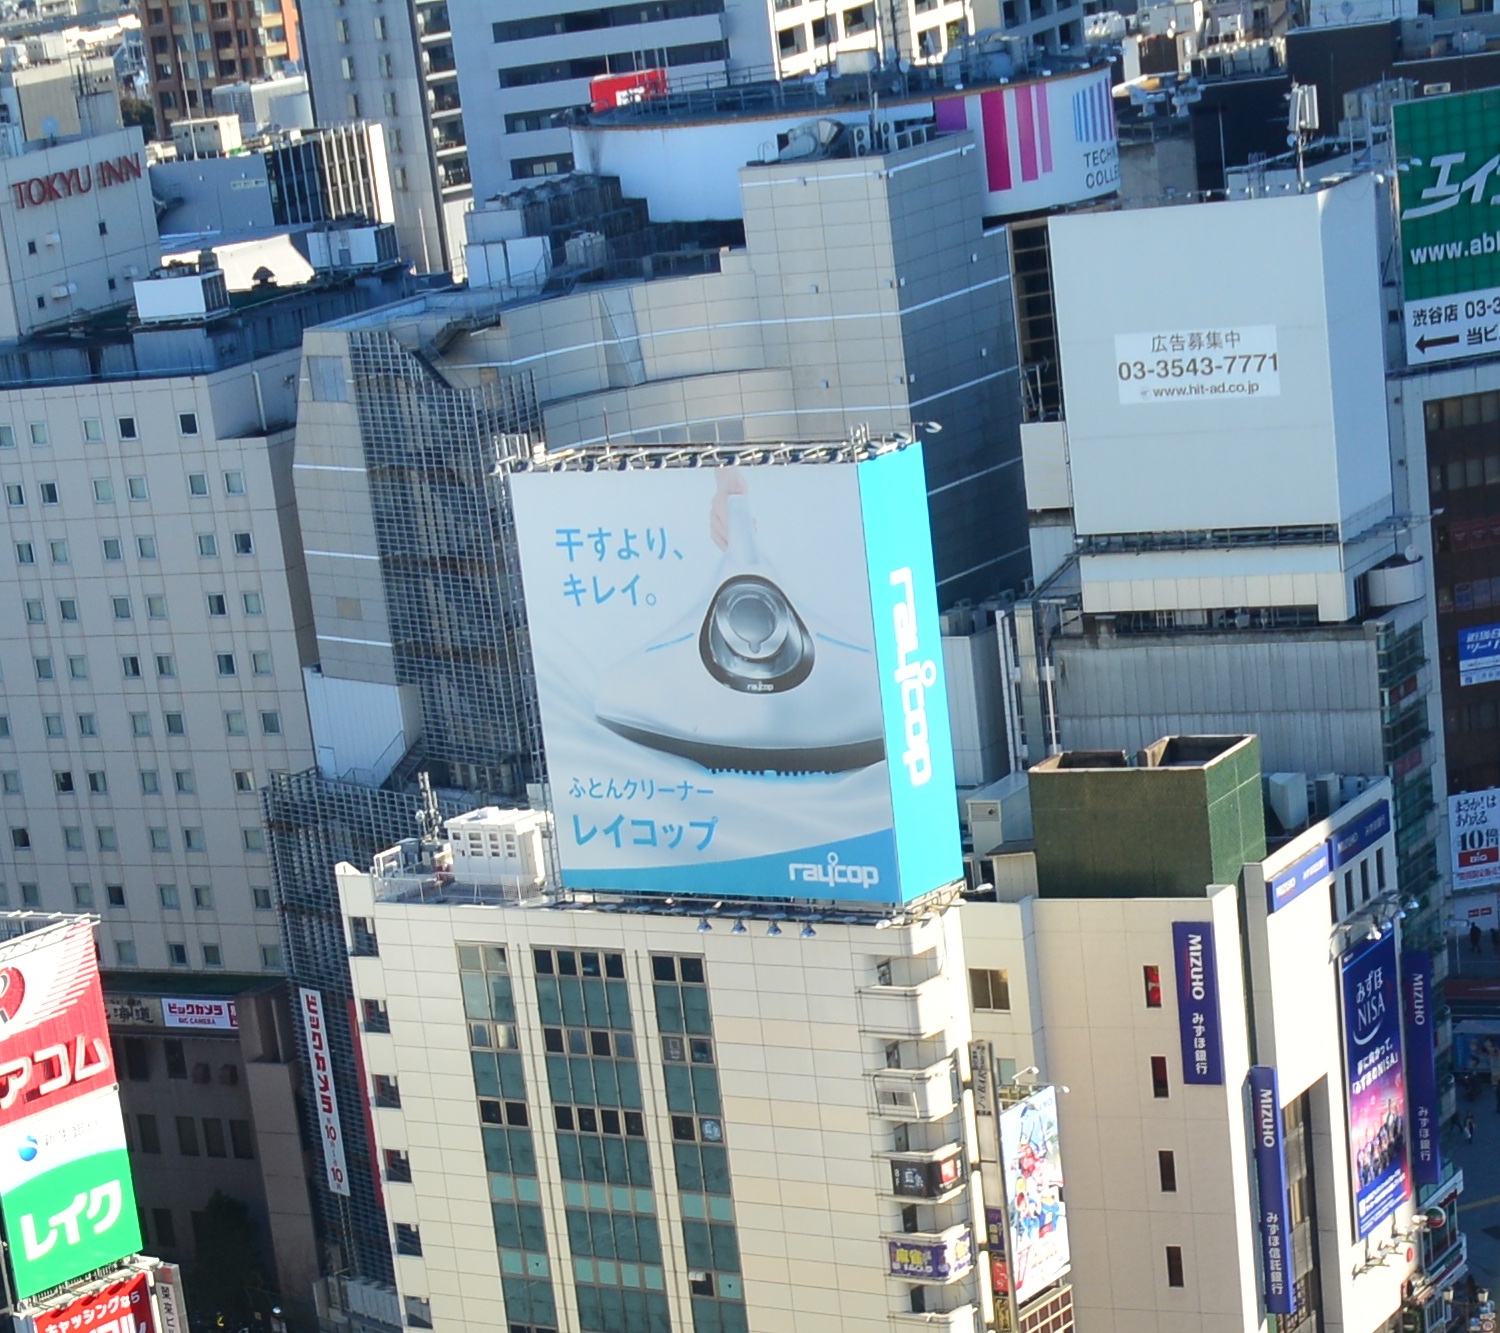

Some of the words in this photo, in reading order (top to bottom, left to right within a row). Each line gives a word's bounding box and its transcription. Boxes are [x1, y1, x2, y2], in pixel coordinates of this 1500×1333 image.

[11, 165, 92, 208] TOKYU
[99, 152, 141, 188] INN
[1413, 303, 1459, 327] 渋谷店
[1151, 330, 1241, 353] 広告募集中
[1118, 352, 1278, 381] 03-3543-7771
[1153, 380, 1259, 398] www.hit-ad.co.jp
[555, 527, 684, 563] 干すより、
[562, 574, 657, 607] キレイ。
[888, 566, 937, 787] raycop
[569, 777, 714, 801] ふとんクリーナー
[572, 813, 718, 851] レイコップ
[788, 851, 880, 889] raycop
[1188, 934, 1205, 1000] MIZUHO
[1356, 966, 1384, 1004] みずほ
[168, 1002, 224, 1017] ビックカメラ
[1357, 995, 1386, 1032] NISA
[1413, 973, 1425, 1026] MIZUHO
[305, 992, 333, 1114] ビックカメラ
[1192, 1013, 1207, 1075] みずほ銀行
[1259, 1088, 1274, 1148] MIZUHO
[1418, 1106, 1431, 1162] みずほ銀行
[20, 1179, 123, 1261] レイク
[1266, 1212, 1283, 1296] みずほ信託銀行
